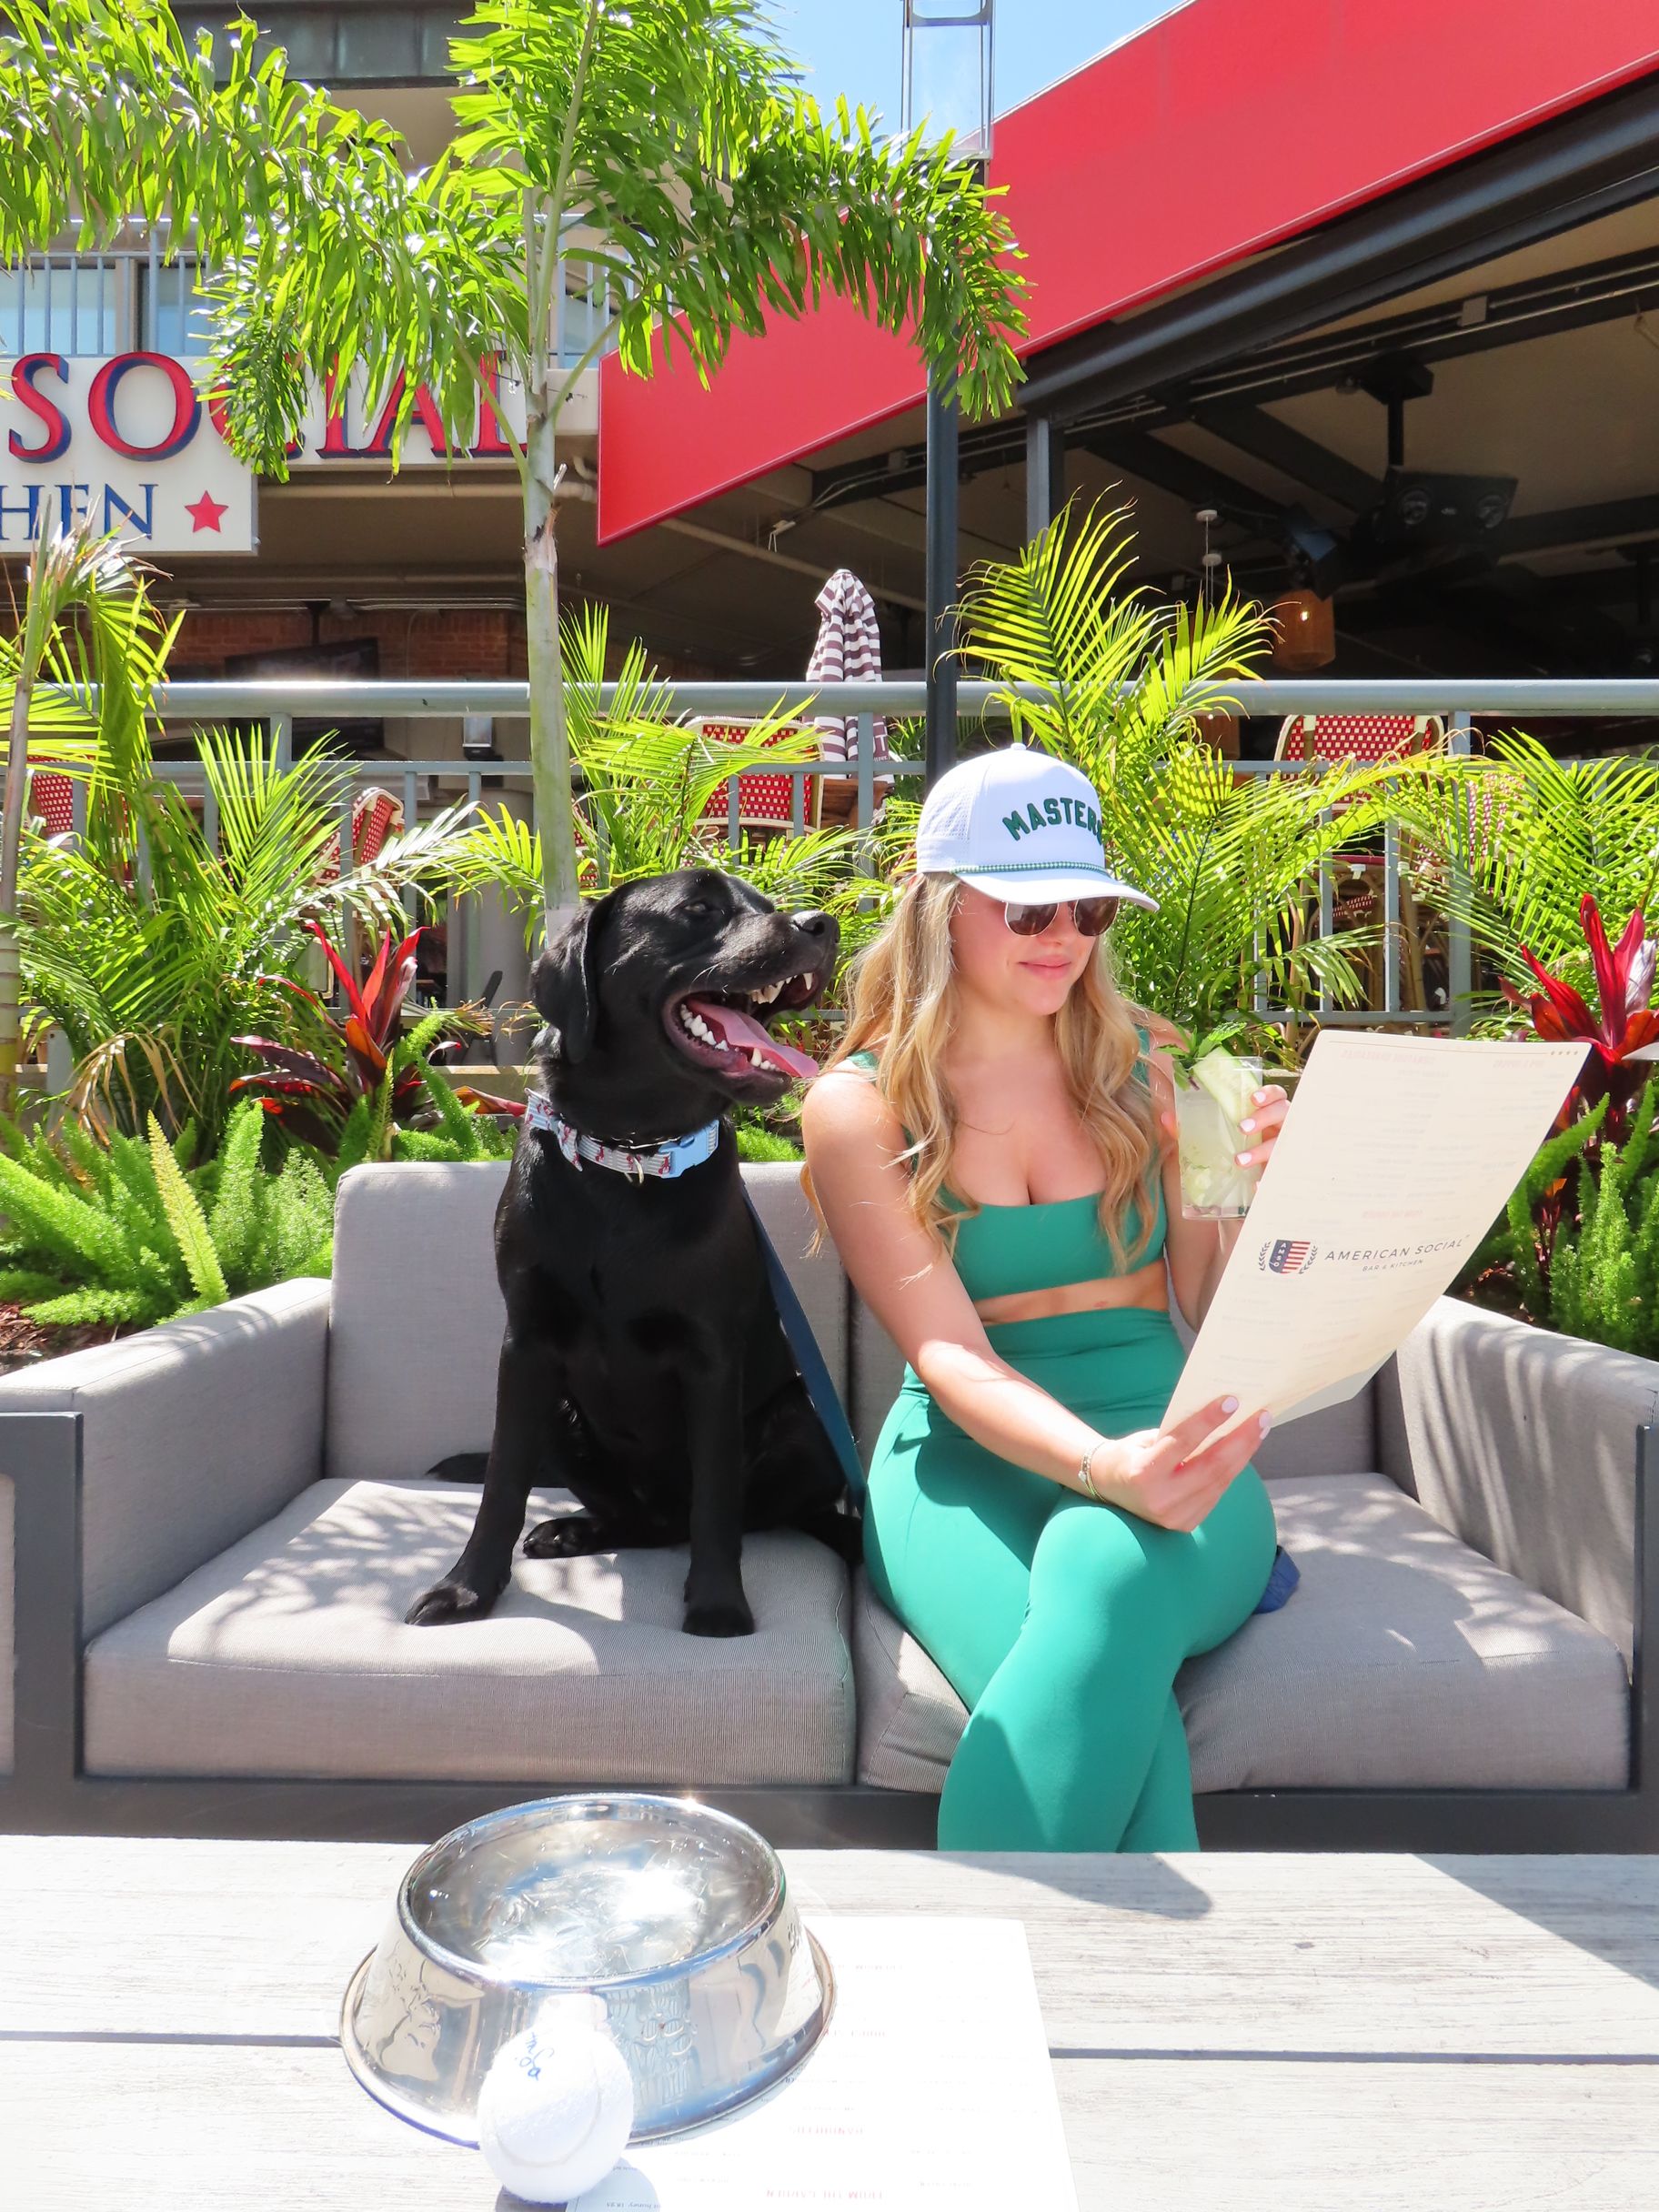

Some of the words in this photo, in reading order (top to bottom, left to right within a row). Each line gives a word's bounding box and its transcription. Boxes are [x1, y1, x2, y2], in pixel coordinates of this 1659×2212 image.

[1324, 1247, 1411, 1261] AMERICAN
[1414, 1239, 1463, 1255] SOCIAL
[1362, 1264, 1379, 1272] BAR
[1390, 1259, 1423, 1269] KITCHEN
